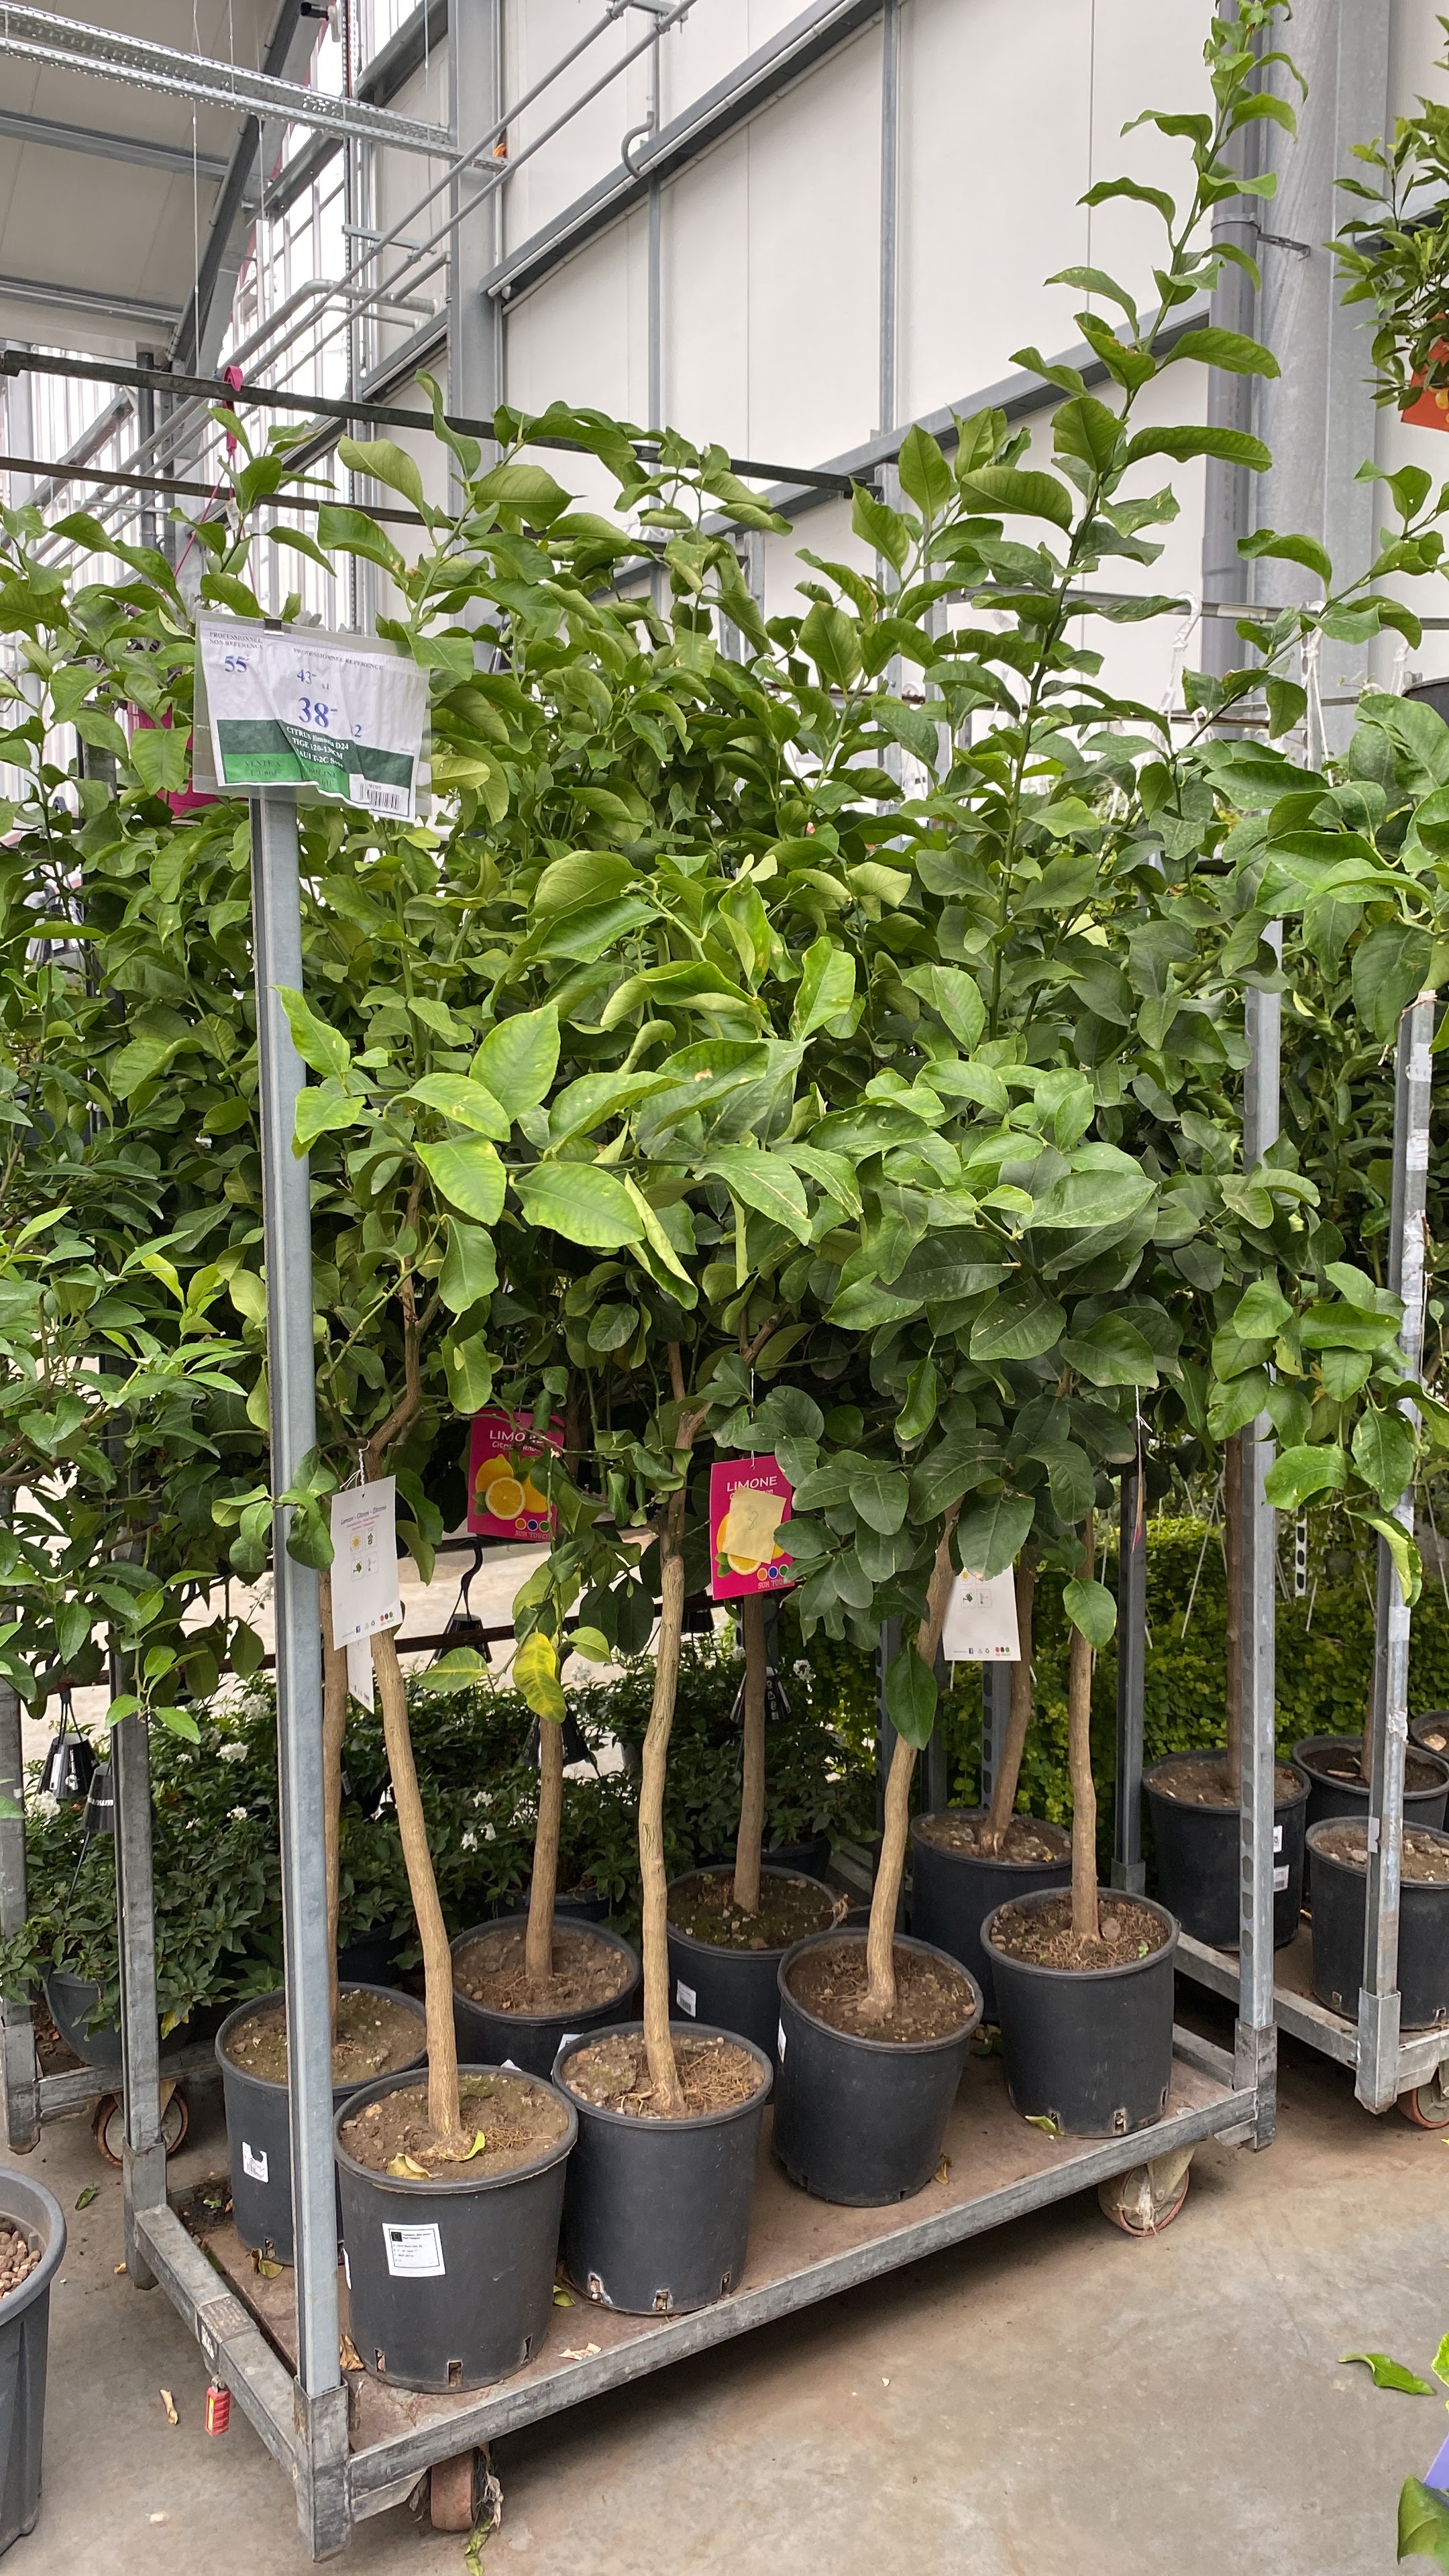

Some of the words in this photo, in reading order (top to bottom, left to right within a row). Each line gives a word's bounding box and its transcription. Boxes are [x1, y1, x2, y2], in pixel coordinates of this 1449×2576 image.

[209, 632, 262, 643] PROFESSIONNEL
[286, 727, 312, 741] CITRUS
[335, 742, 350, 751] D24
[292, 737, 310, 749] TIGE
[727, 1476, 778, 1493] LIMONE
